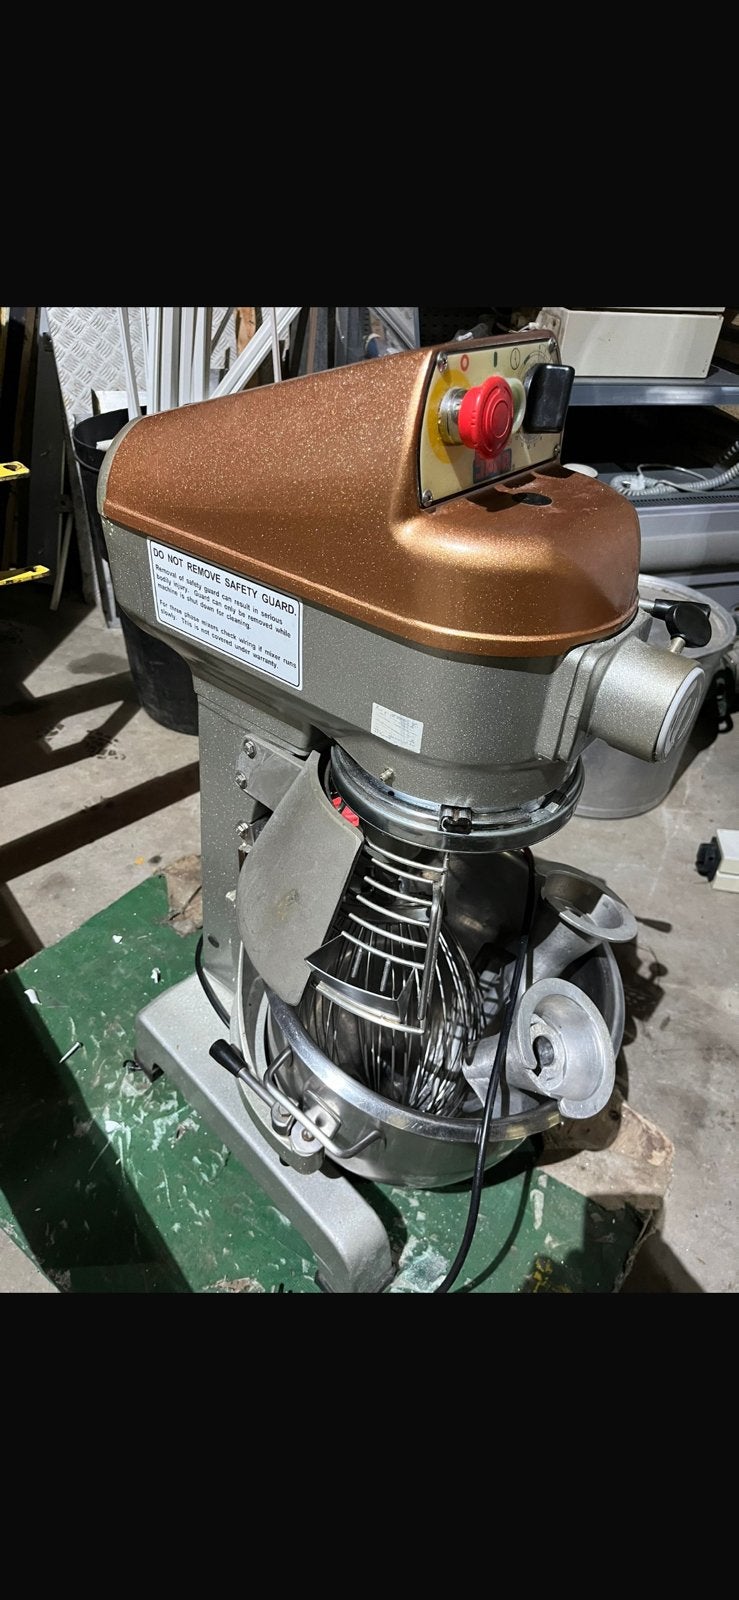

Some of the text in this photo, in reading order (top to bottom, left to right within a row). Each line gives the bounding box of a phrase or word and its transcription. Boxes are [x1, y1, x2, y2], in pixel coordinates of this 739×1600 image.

[153, 548, 297, 616] DO NOT REMOVE SAFETY GUARD.
[156, 564, 176, 578] Removal
[186, 578, 202, 590] safety
[204, 587, 220, 598] guard
[222, 594, 232, 602] can
[234, 599, 250, 611] result
[253, 606, 258, 614] in
[261, 610, 282, 625] serious
[157, 574, 172, 586] bodily
[194, 590, 210, 602] Guard
[224, 604, 236, 614] only
[238, 609, 246, 618] be
[248, 614, 272, 630] removed
[276, 626, 291, 638] while
[158, 584, 178, 596] machine
[187, 596, 198, 606] shut
[200, 602, 214, 612] down
[216, 608, 224, 616] for
[226, 614, 251, 630] cleaning.
[160, 600, 168, 608] For
[221, 628, 236, 640] check
[239, 638, 256, 650] wiring
[264, 650, 280, 660] mixer
[283, 658, 296, 668] runs
[182, 618, 192, 628] This
[201, 628, 210, 636] not
[212, 634, 232, 646] covered
[235, 644, 250, 655] under
[252, 652, 278, 669] warranty.
